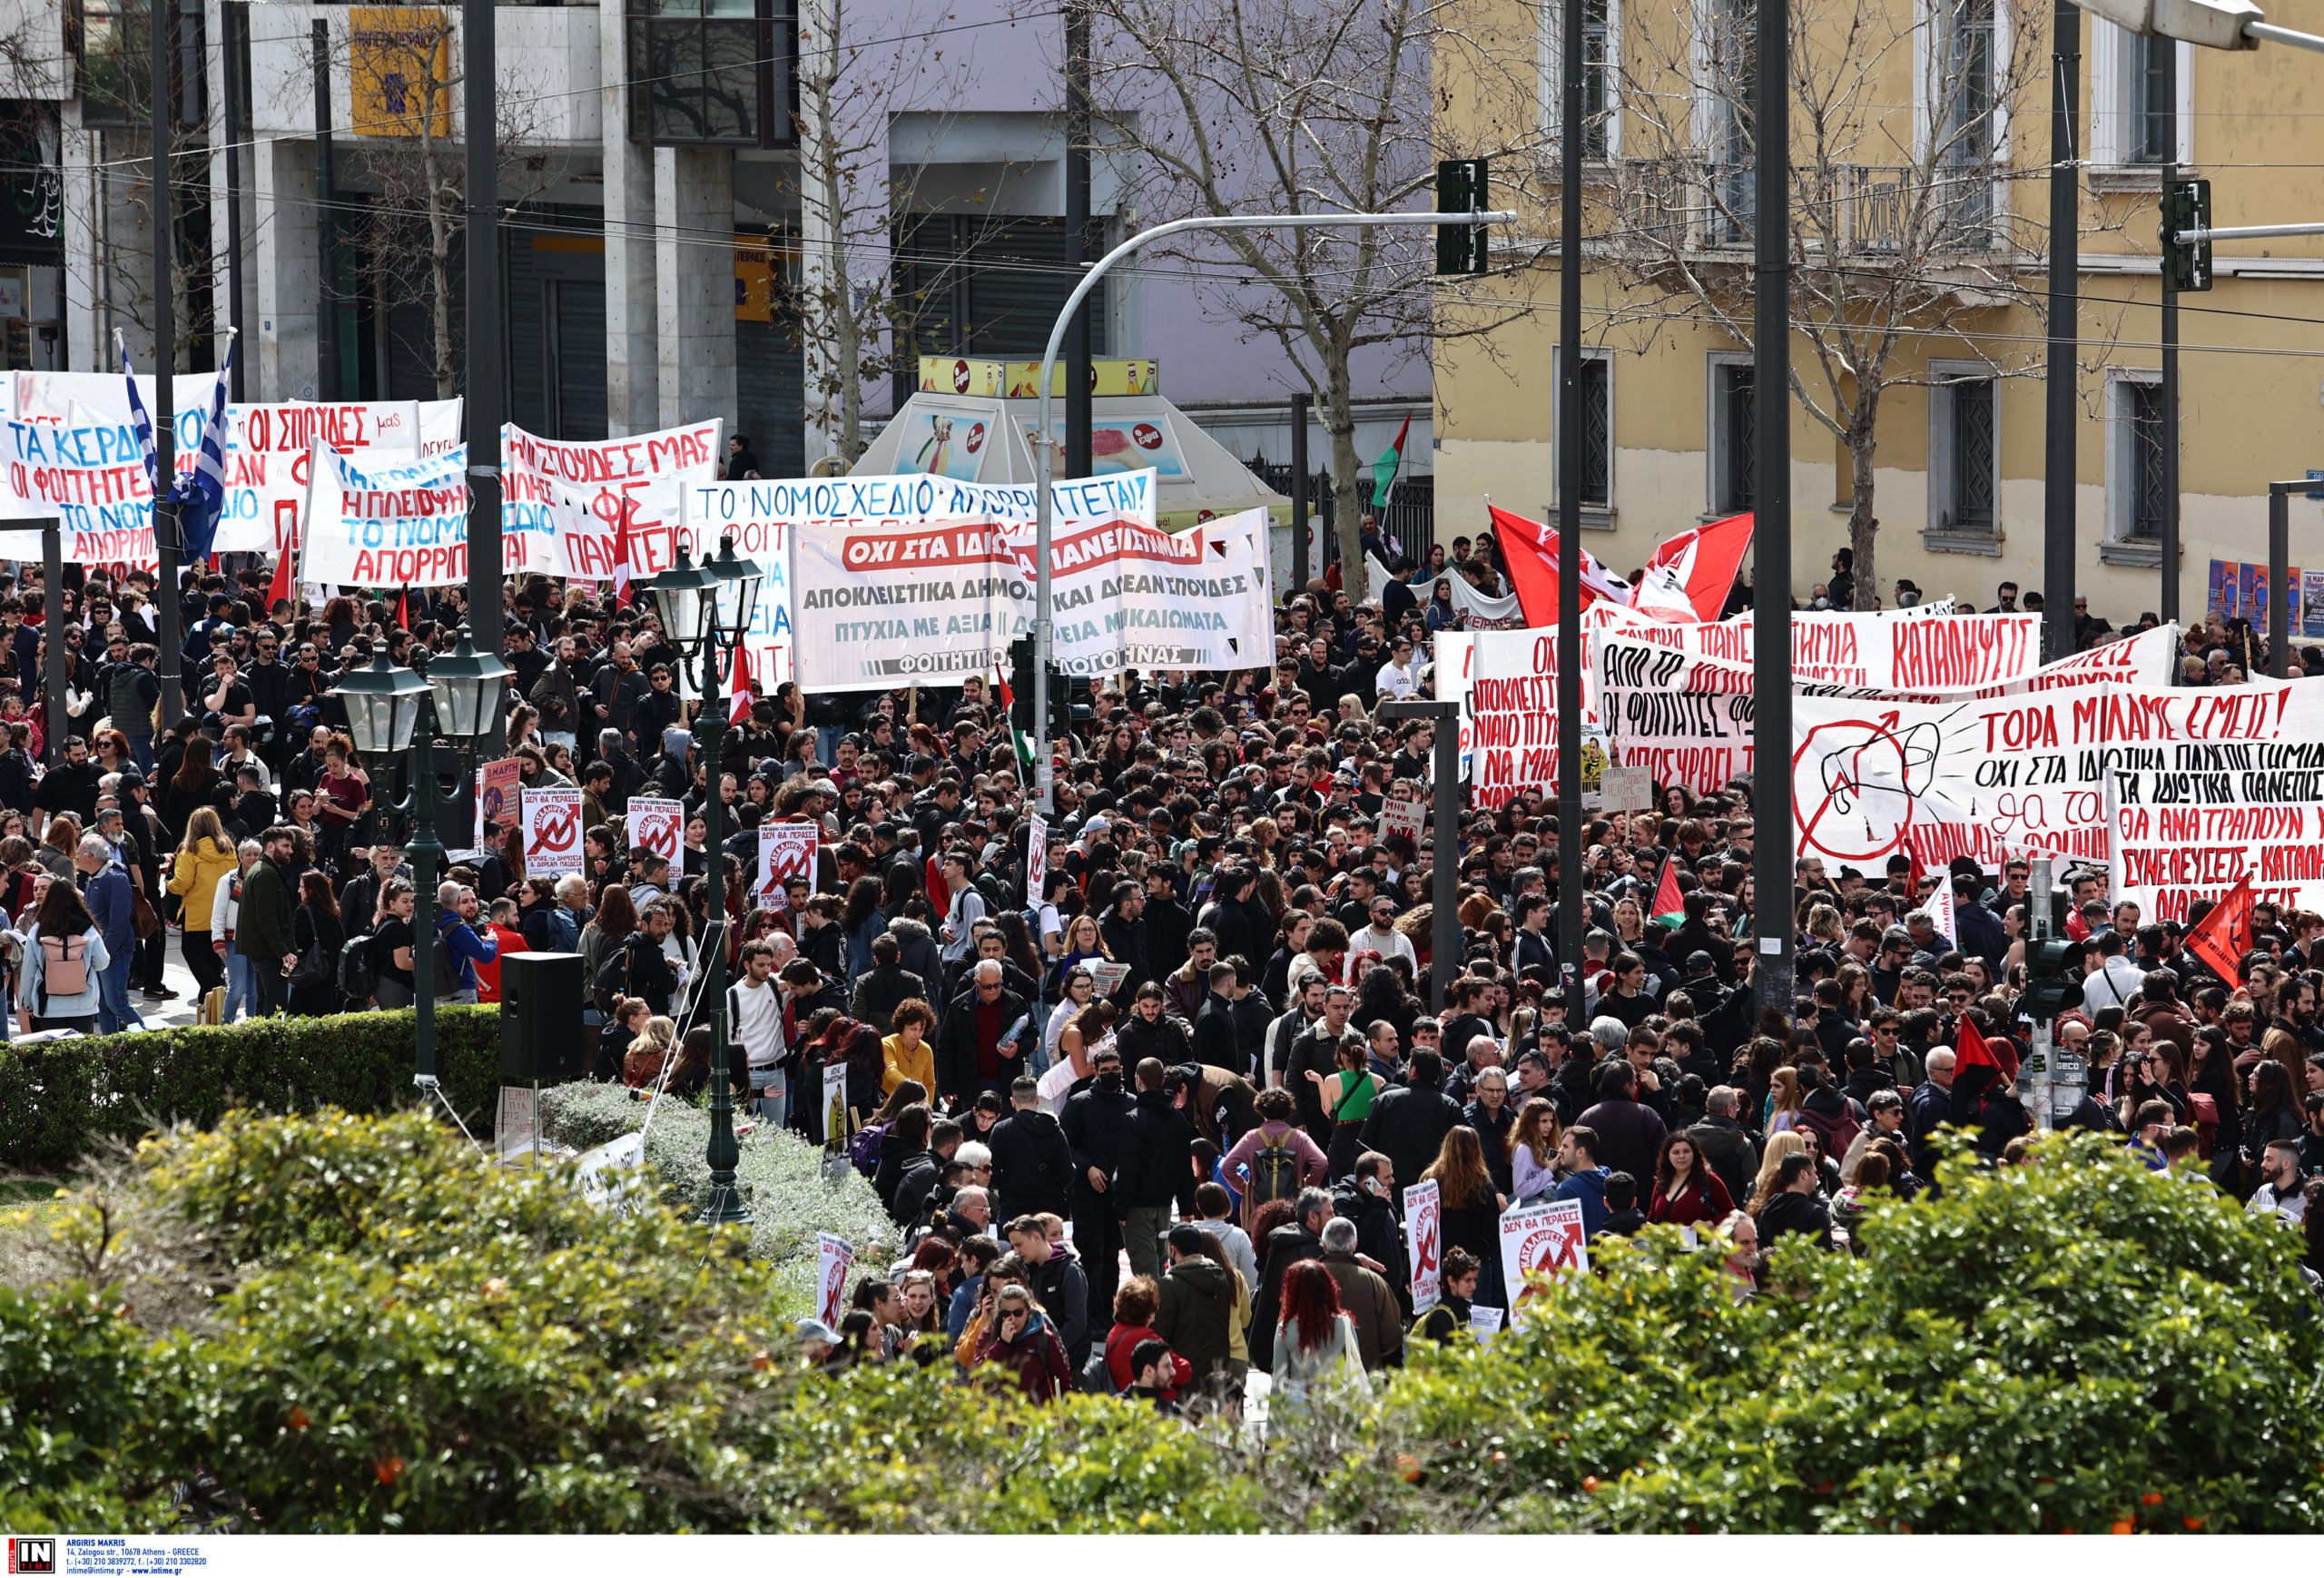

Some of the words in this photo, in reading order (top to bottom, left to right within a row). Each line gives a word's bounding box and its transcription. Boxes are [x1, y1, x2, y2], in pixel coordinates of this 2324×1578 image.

[8, 421, 48, 464] ΤΑ
[249, 409, 270, 452] ΟΙ
[278, 406, 369, 452] ΣΠΟΥΔΕΣ
[377, 413, 400, 438] μας
[536, 442, 645, 483] ΣΠΟΥΔΕΣ
[647, 429, 714, 473] ΜΑΣ
[11, 461, 30, 499] ΟΙ
[34, 465, 154, 506] ΦΟΙΤΗΤΕ
[341, 491, 360, 518] Η
[368, 484, 468, 518] ΠΛΕΙΟΨΗ
[696, 488, 735, 519] ΤΟ
[752, 479, 934, 518] ΝΟΜΟΣΧΕΔΙΟ
[60, 503, 93, 531] ΤΟ
[341, 518, 383, 547] ΤΟ
[74, 527, 159, 560] ΑΠΟΡΡΙΠ
[848, 540, 895, 565] ΟΧΙ
[901, 536, 950, 561] ΣΤΑ
[803, 580, 956, 609] ΑΠΟΚΛΕΙΣΤΙΚΑ
[961, 577, 1036, 603] ΔΗΜΟ
[1052, 585, 1094, 613] ΚΑΙ
[1166, 575, 1248, 597] ΣΠΟΥΔΕΣ
[835, 620, 909, 642] ΠΤΥΧΙΑ
[913, 616, 939, 637] ΜΕ
[946, 612, 992, 635] ΑΞΙΑ
[1123, 607, 1228, 630] ΙΚΑΙΩΜΑΤΑ
[1125, 644, 1182, 664] ΗΝΑΣ
[1603, 643, 1651, 688] ΑΠΟ
[1650, 650, 1685, 687] ΤΟ
[1892, 618, 2034, 689] ΚΑΤΑΛΗΨΕΙΣ
[1474, 675, 1560, 713] ΑΠΟΚΛΕΙΣΤ
[1474, 714, 1521, 748] ΝΙΑΙΟ
[1603, 691, 1620, 737] ΟΙ
[1627, 691, 1728, 738] ΦΟΙΤΗΤΕΣ
[2073, 693, 2182, 745] ΜΙΛΑΜΕ
[2186, 685, 2292, 740] ΕΜΕΙΣ!
[492, 763, 518, 777] ΜΑΡΤΗ
[1483, 748, 1514, 787] ΝΑ
[1975, 759, 2019, 788] ΟΧΙ
[2025, 754, 2067, 786] ΣΤΑ
[525, 795, 537, 804] ΔΕΝ
[2114, 772, 2141, 804] ΤΑ
[1385, 801, 1406, 813] ΜΗΝ
[2119, 807, 2149, 841] ΘΑ
[2160, 806, 2303, 841] ΑΝΑΤΡΑΠΟΥΝ
[763, 832, 774, 840] ΔΕΝ
[790, 831, 815, 839] ΠΕΡΑΣΕΙ
[2122, 846, 2250, 887] ΣΥΝΕΛΕΥΣΕΙΣ
[1503, 1222, 1521, 1234] ΔΕΝ
[1525, 1219, 1538, 1229] ΘΑ
[1541, 1210, 1580, 1227] ΠΕΡΑΣΕΙ
[1521, 1231, 1565, 1268] ΚΑΤΑΛΗΨΕΙΣ
